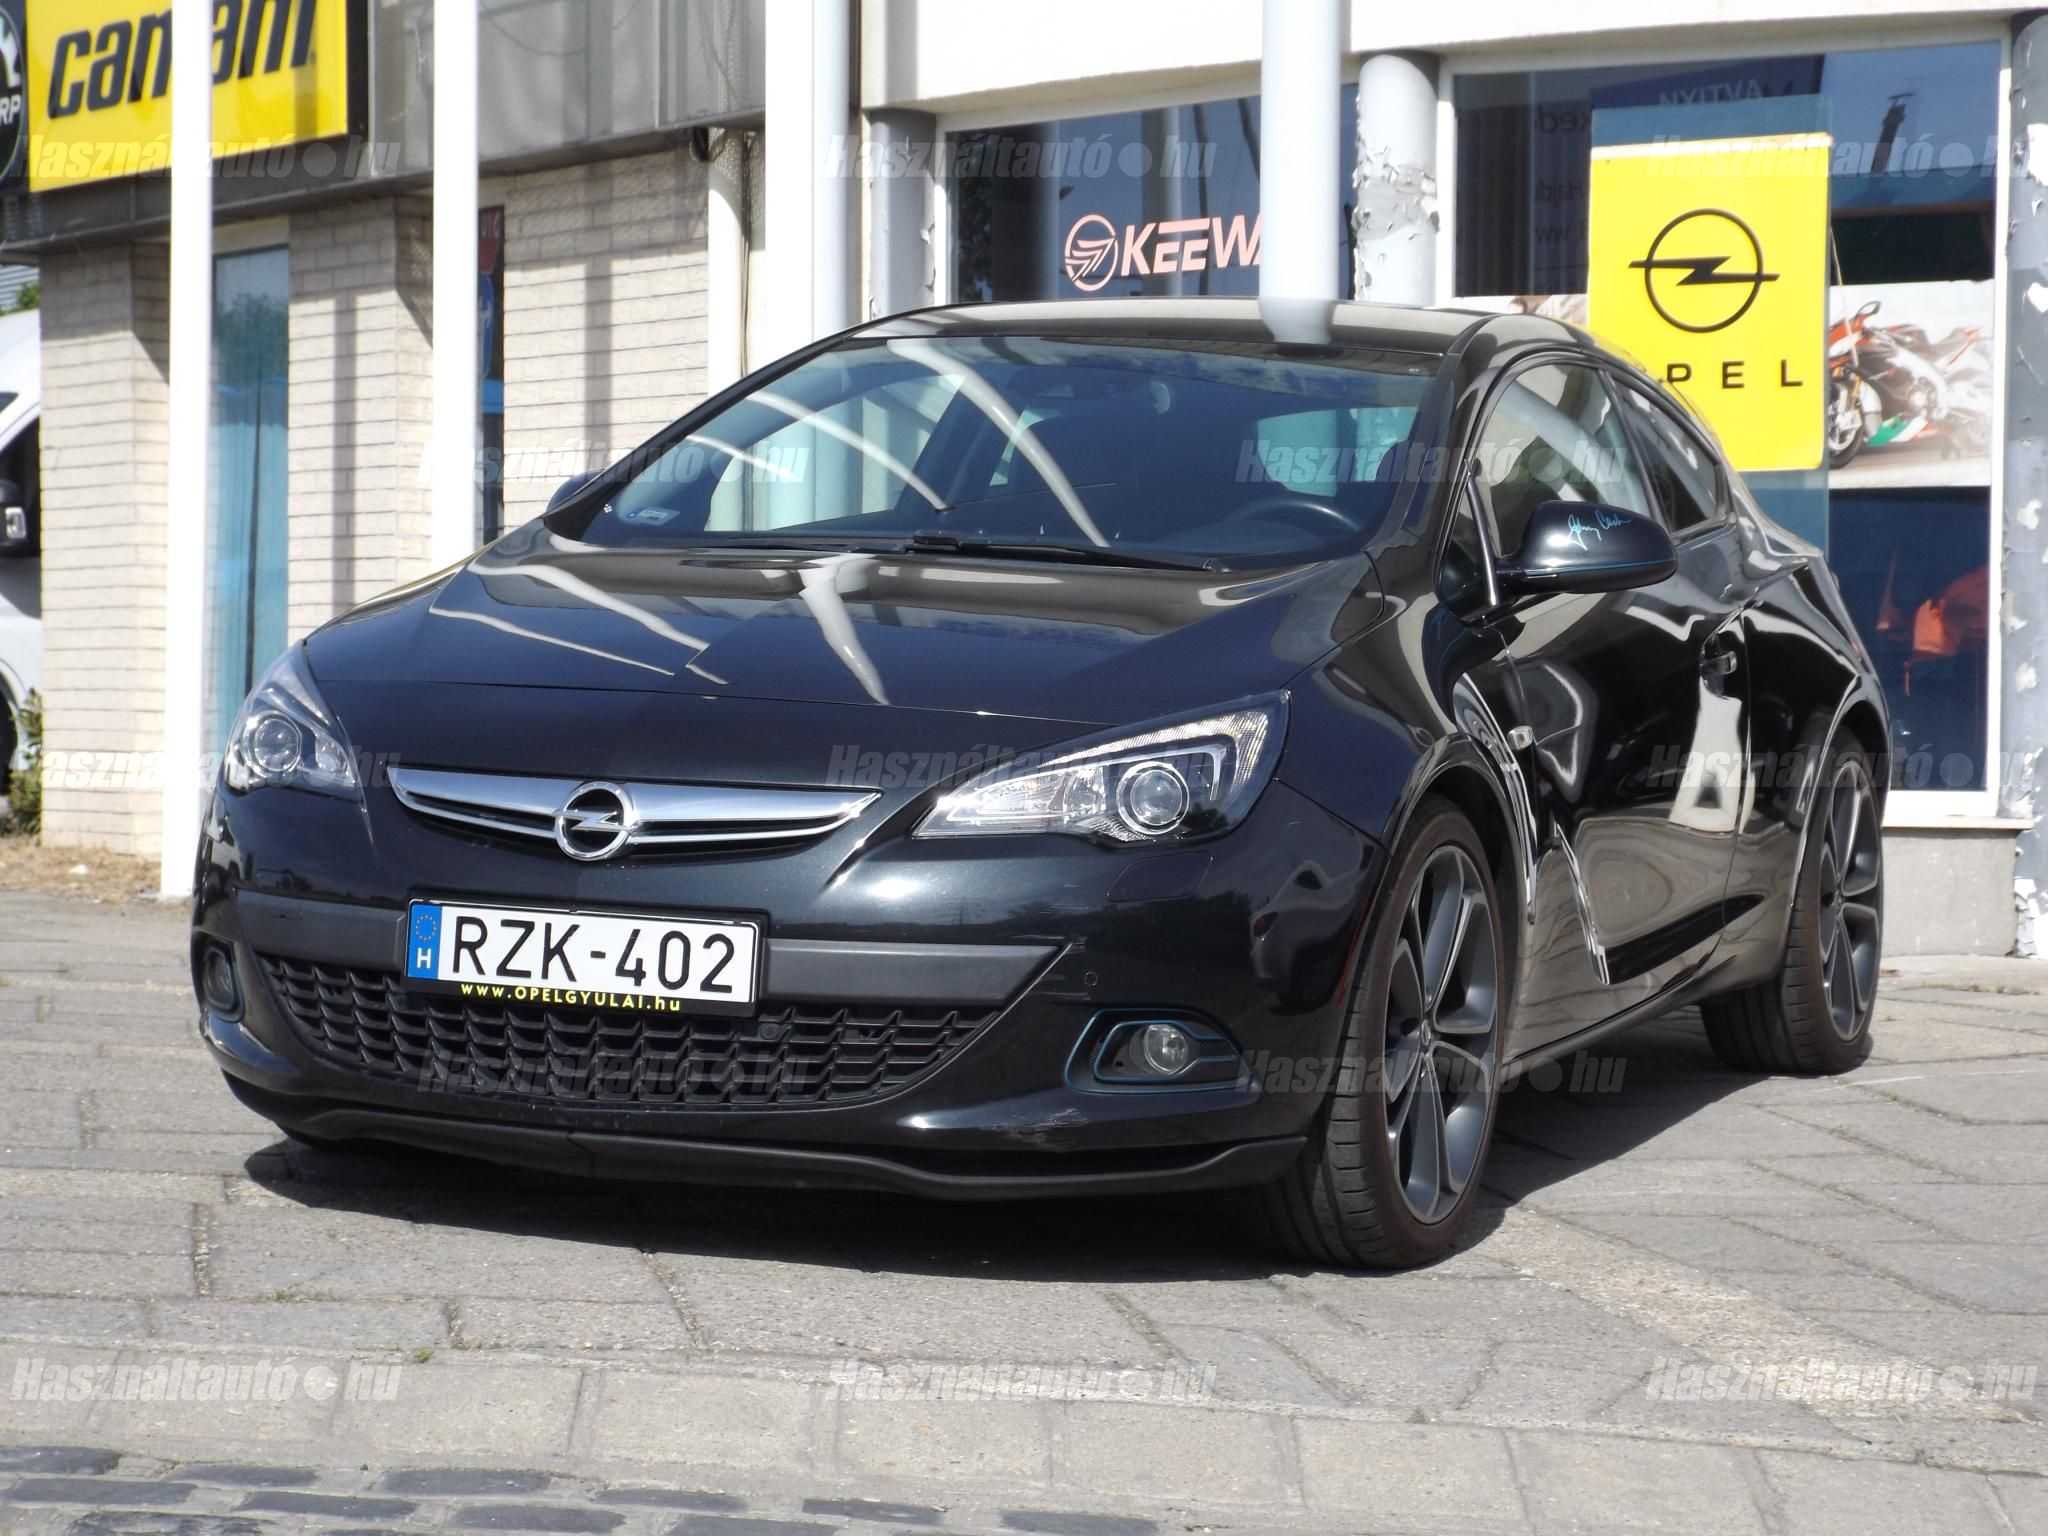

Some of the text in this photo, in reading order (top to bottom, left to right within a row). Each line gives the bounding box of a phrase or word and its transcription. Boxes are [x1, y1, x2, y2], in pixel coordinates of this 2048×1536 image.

[47, 0, 317, 120] canam
[0, 94, 22, 125] RP
[1121, 213, 1261, 277] KEEW
[1667, 359, 1803, 389] PEL
[416, 947, 433, 969] H
[452, 915, 735, 994] RZK-402
[460, 983, 681, 1012] www.OPELGYULAI.hu
